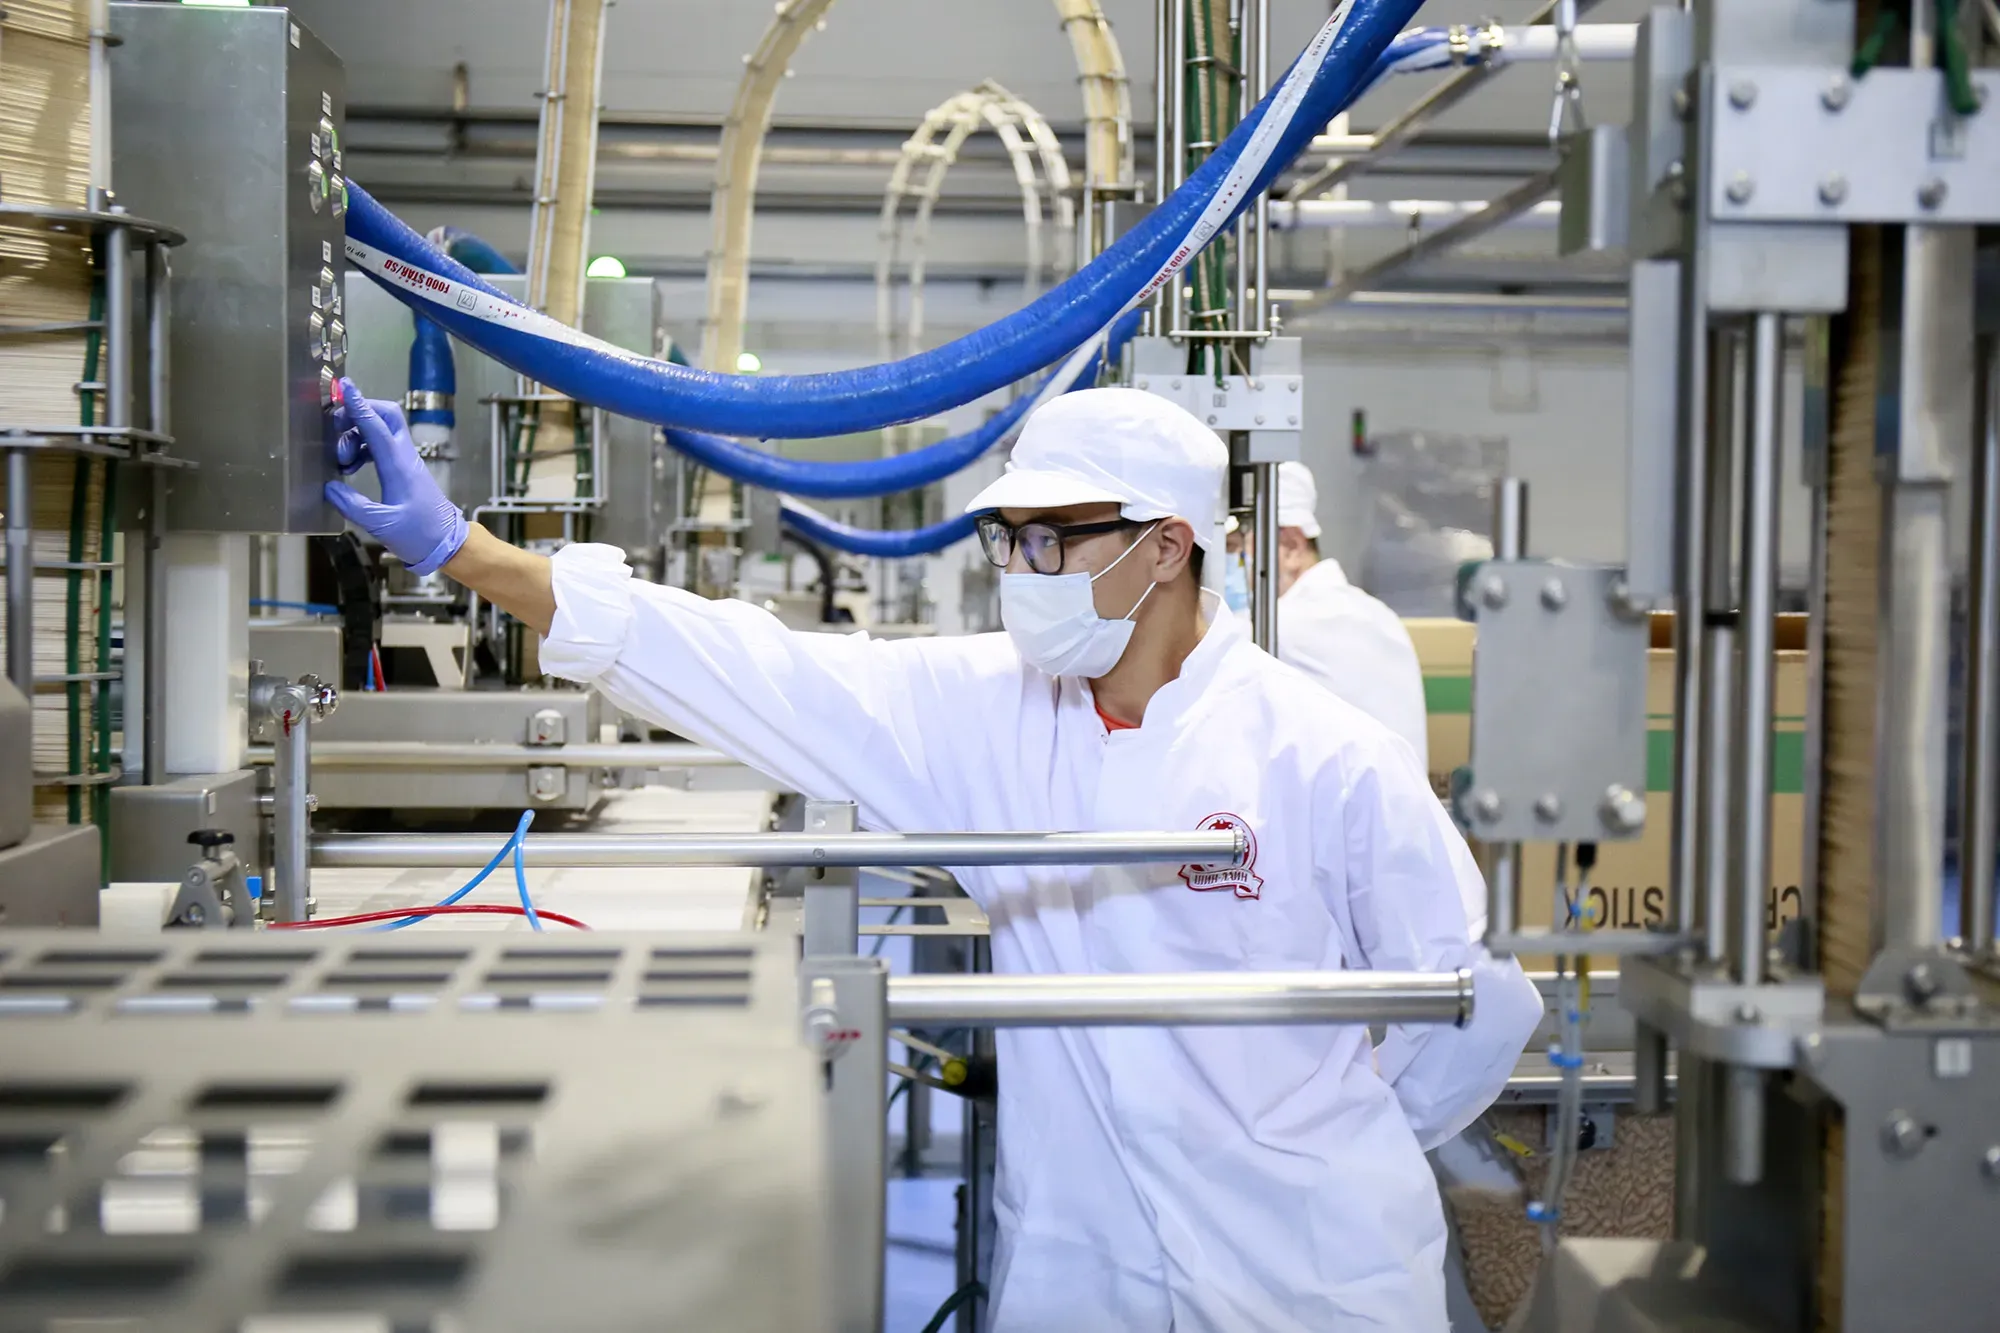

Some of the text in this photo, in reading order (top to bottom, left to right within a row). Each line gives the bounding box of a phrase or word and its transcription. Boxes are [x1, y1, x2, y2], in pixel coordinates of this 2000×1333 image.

[1170, 245, 1190, 268] FOOD
[384, 259, 450, 293] FOOD STAR/SD
